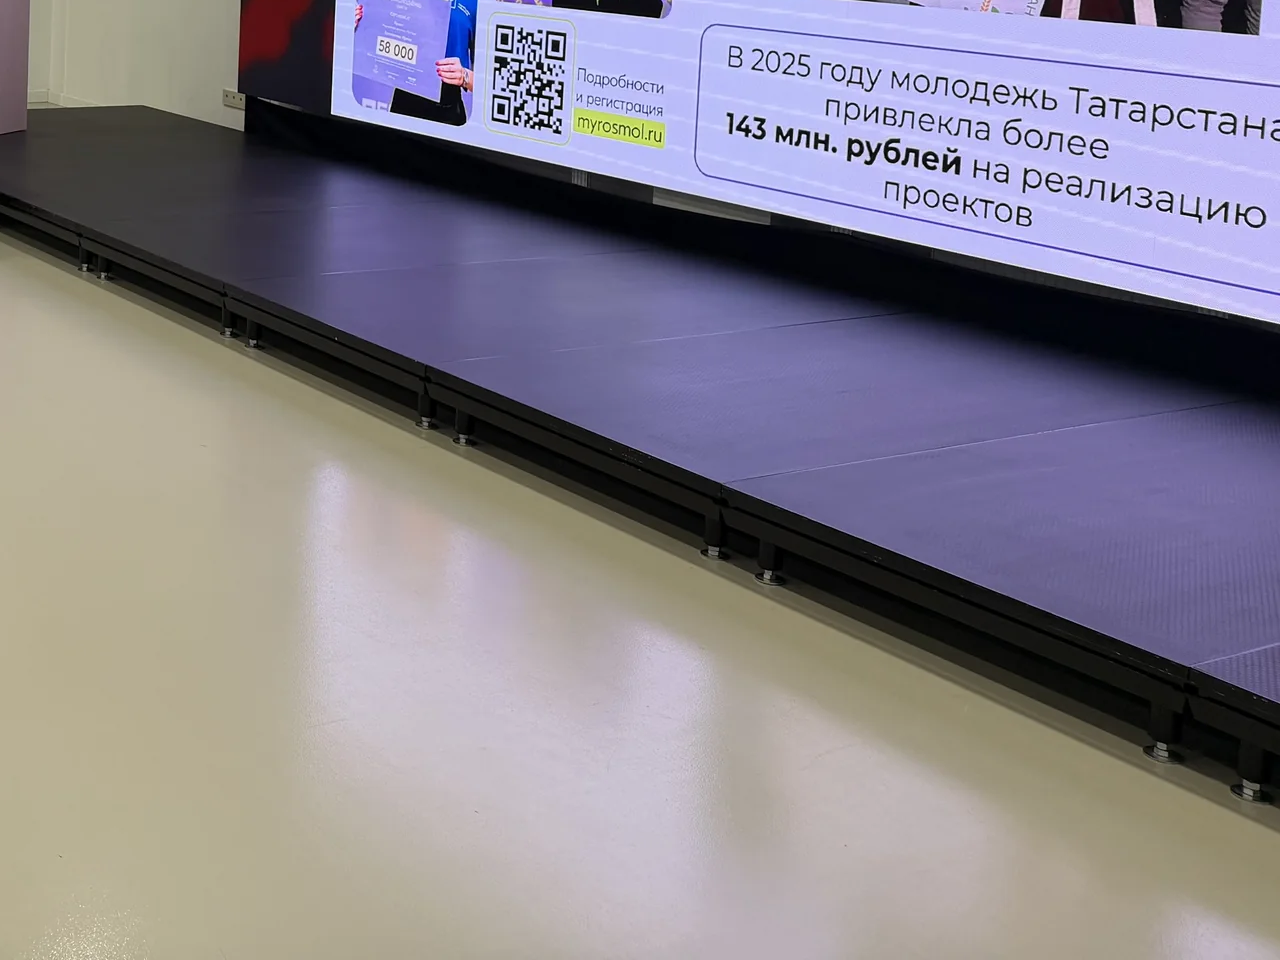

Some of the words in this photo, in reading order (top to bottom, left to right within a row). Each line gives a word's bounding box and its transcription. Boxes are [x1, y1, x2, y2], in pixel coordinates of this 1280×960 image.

[378, 39, 391, 54] 58
[393, 43, 414, 61] 000
[577, 67, 665, 95] Подробности
[728, 45, 743, 69] В
[751, 47, 811, 78] 2025
[819, 62, 882, 92] году
[891, 71, 1058, 112] молодежь
[586, 94, 664, 117] регистрация
[577, 114, 663, 144] myrosmol.ru
[824, 96, 991, 142] привлекла
[1003, 116, 1110, 161] более
[726, 112, 767, 141] 143
[774, 129, 838, 155] млн.
[846, 135, 962, 177] рублей
[973, 159, 1010, 184] на
[1022, 165, 1268, 230] реализацию
[883, 180, 1033, 229] проектов
